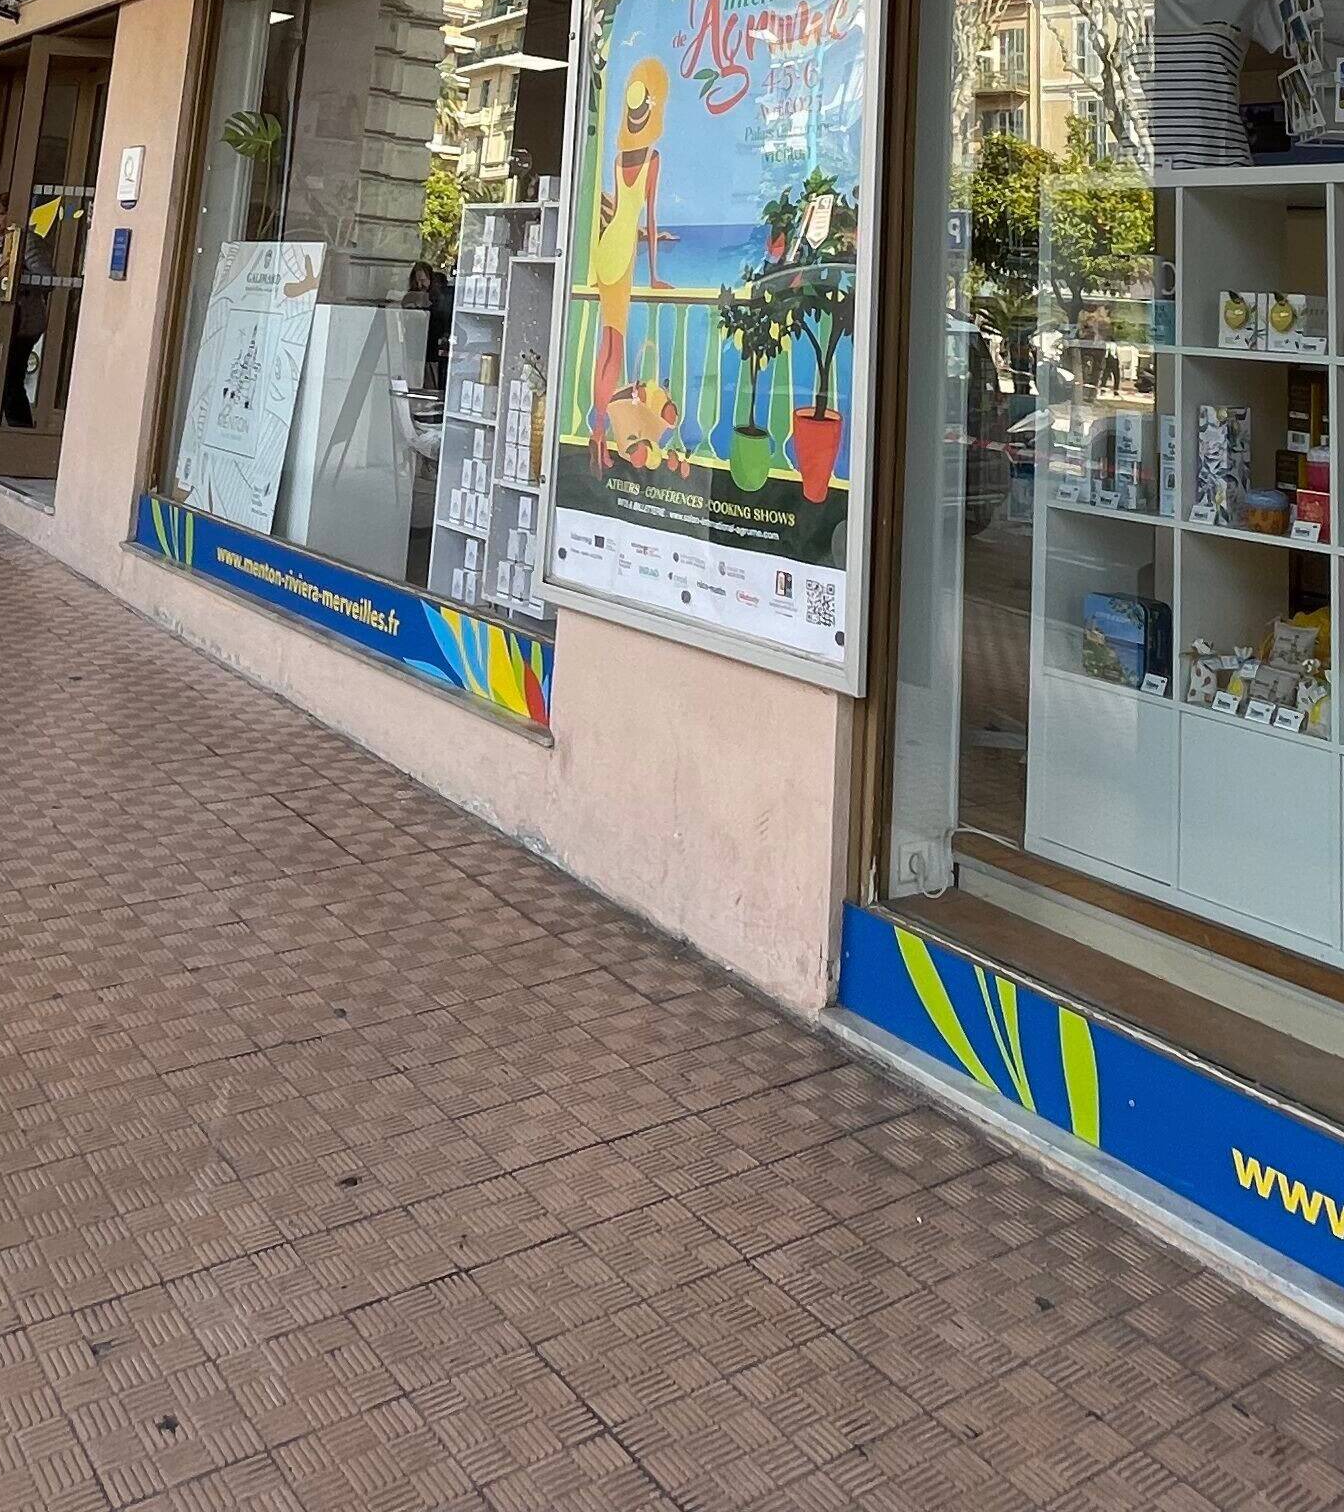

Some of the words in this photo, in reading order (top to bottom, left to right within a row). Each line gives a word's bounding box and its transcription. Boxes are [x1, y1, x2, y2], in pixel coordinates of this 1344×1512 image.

[707, 498, 751, 520] COOKING
[752, 507, 796, 528] SHOWS
[216, 546, 401, 636] www.menton-riviera-merveilles.fr
